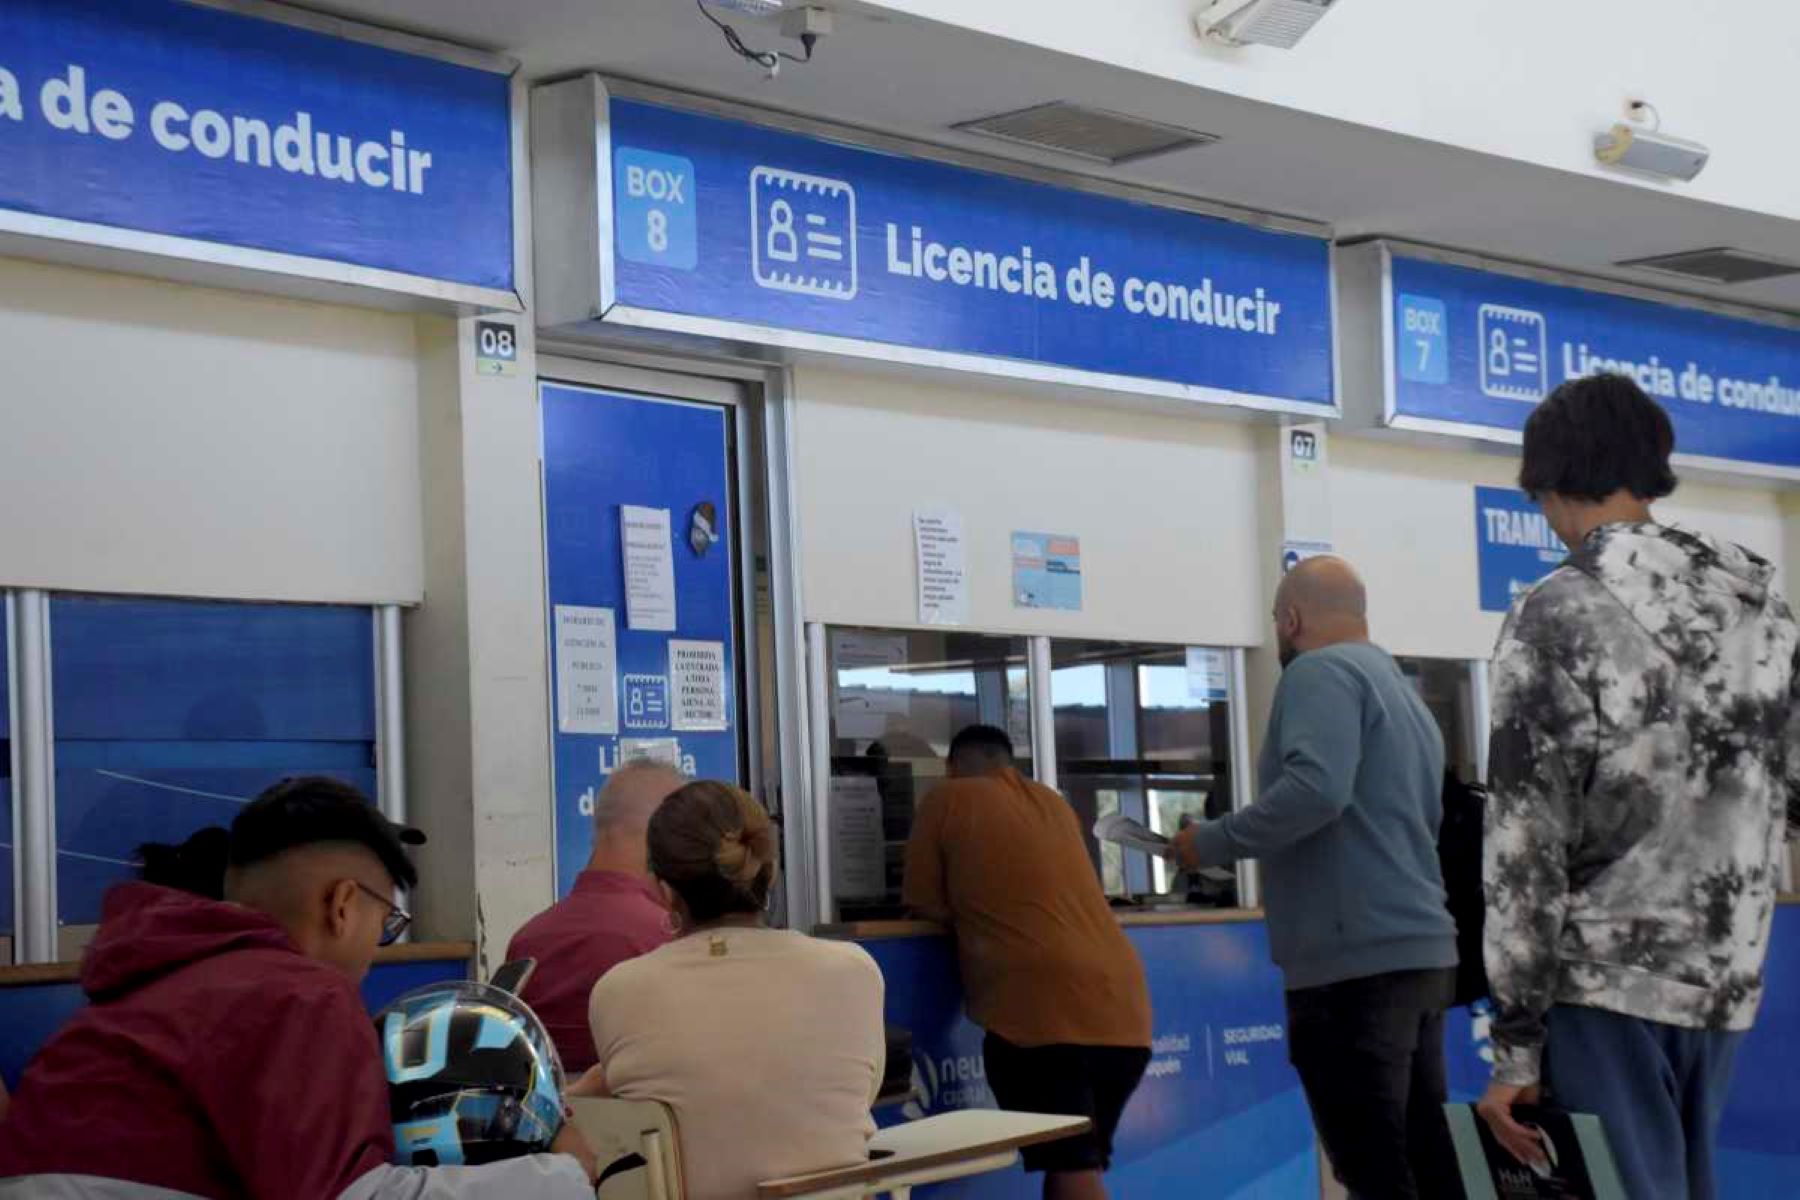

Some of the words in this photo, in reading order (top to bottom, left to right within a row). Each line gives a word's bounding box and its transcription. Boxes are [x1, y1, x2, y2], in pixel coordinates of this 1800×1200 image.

[40, 65, 135, 140] de
[150, 99, 432, 194] conducir
[626, 164, 685, 205] BOX
[646, 208, 668, 252] 8
[887, 222, 1058, 301] Licencia
[1065, 255, 1115, 308] de
[1123, 276, 1281, 335] conducir
[1404, 307, 1441, 336] BOX
[481, 327, 514, 357] 08
[1415, 340, 1430, 372] 7
[1679, 361, 1714, 403] de
[1717, 374, 1800, 417] condu
[1293, 435, 1315, 457] 07
[1483, 507, 1569, 550] TRAMI
[599, 737, 697, 776] Liia
[579, 786, 595, 817] d
[1223, 1024, 1283, 1044] SEGURIDAD
[941, 1056, 985, 1082] neu
[1224, 1047, 1249, 1066] VIAL
